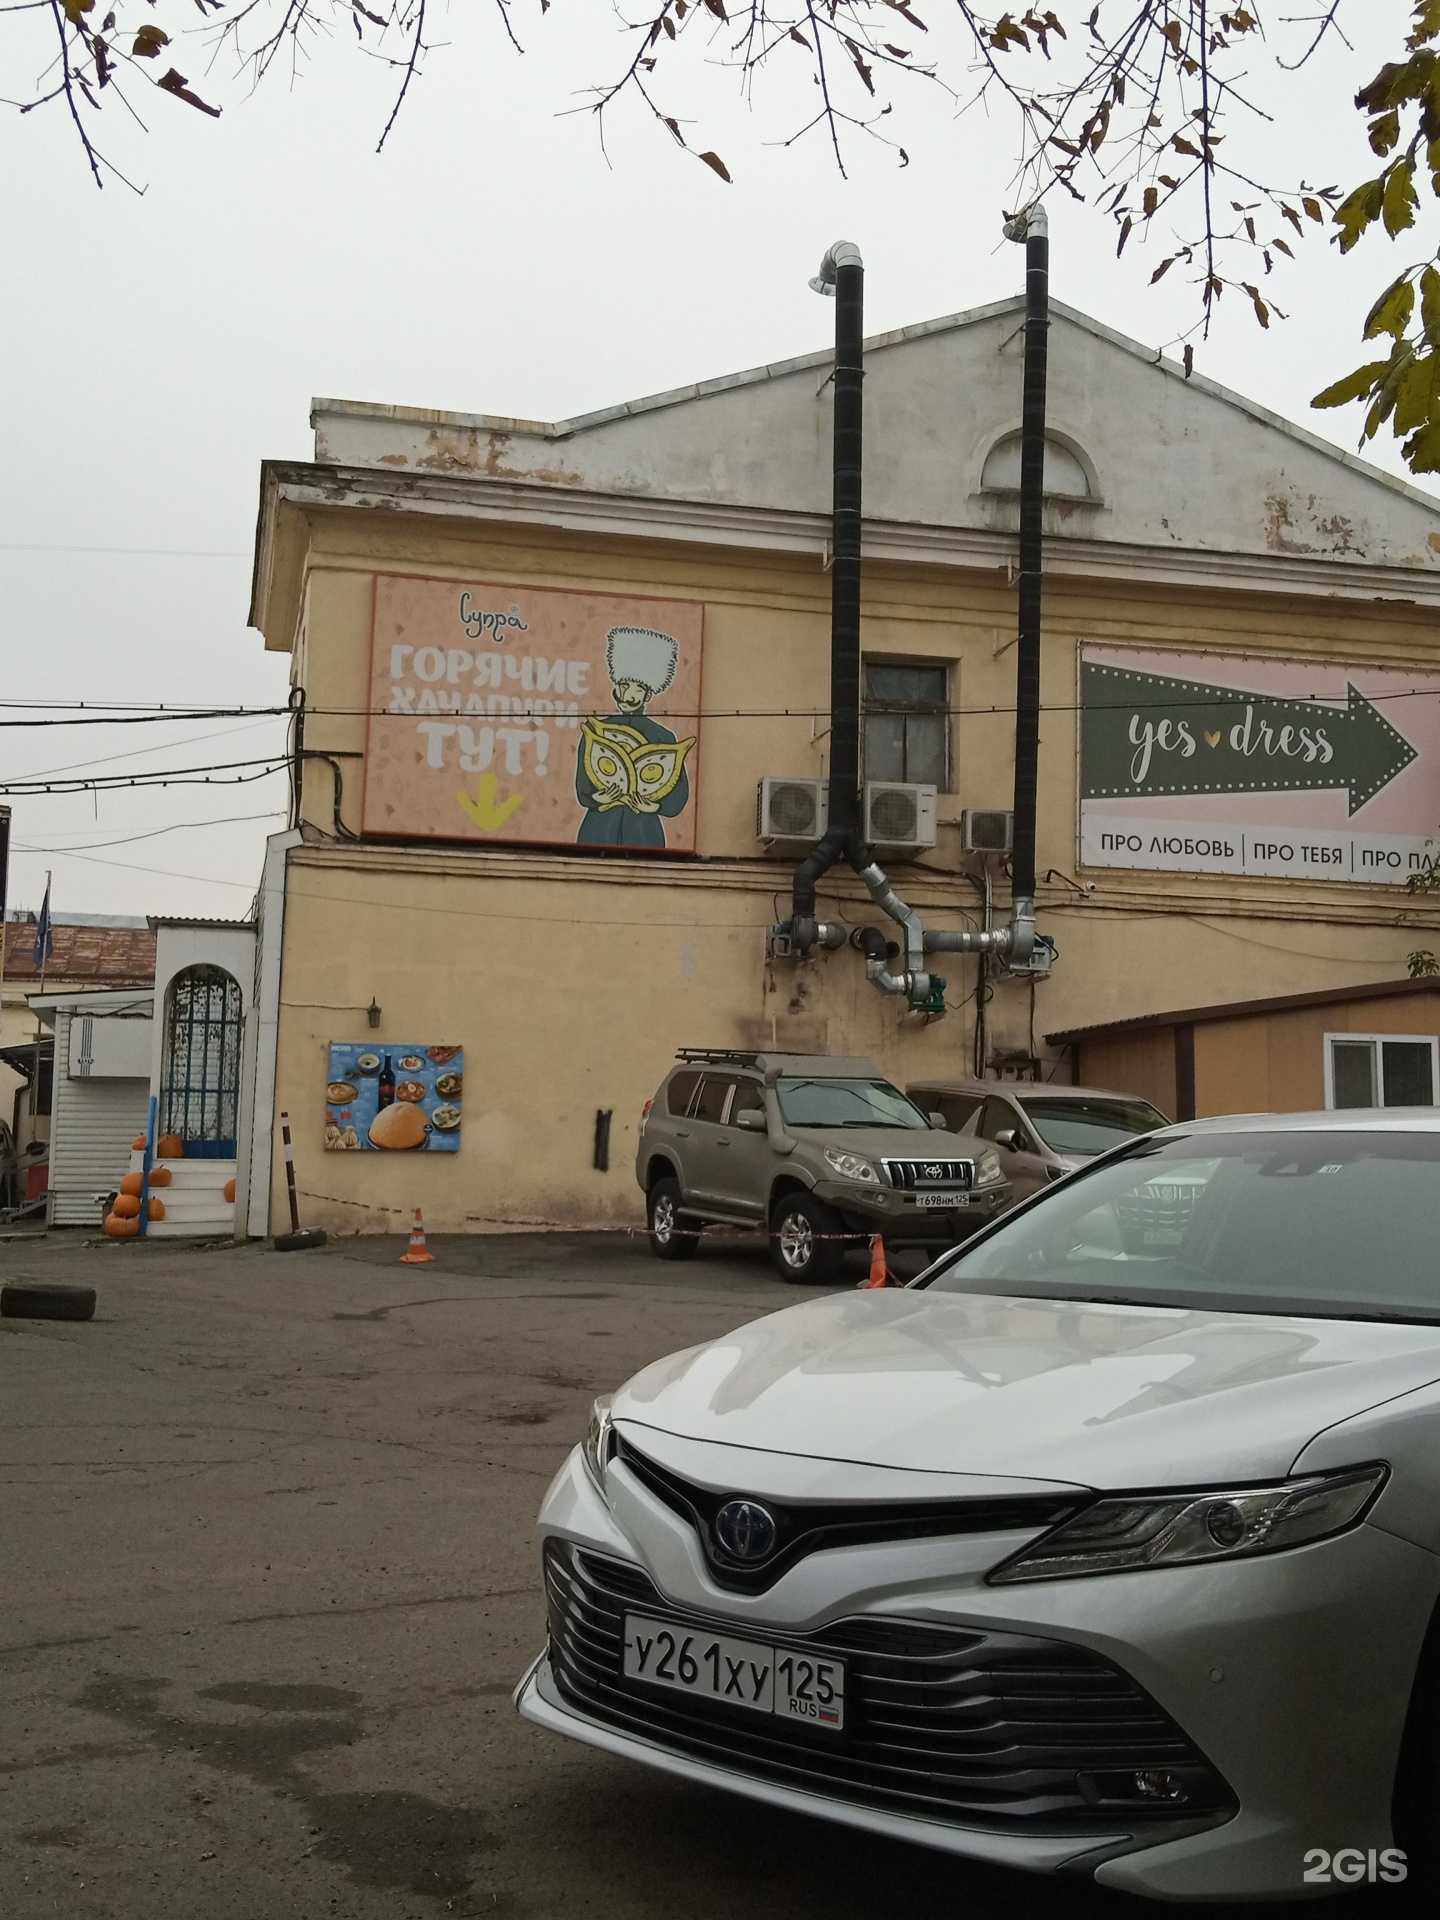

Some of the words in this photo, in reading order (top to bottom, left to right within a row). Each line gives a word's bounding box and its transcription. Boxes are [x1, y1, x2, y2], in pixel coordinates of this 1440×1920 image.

[460, 592, 528, 642] Супра
[390, 644, 592, 695] ГОРЯЧИЕ
[388, 686, 578, 728] ХАЧАПУРИ
[416, 721, 550, 776] ТУТ!
[1128, 713, 1197, 784] yes
[1229, 704, 1334, 764] dress
[1101, 833, 1142, 853] ПРО
[1150, 836, 1234, 858] ЛЮБОВЬ
[1254, 843, 1294, 862] ПРО
[1301, 846, 1343, 866] ТЕБЯ
[1362, 850, 1401, 868] ПРО
[778, 1656, 834, 1704] 125
[789, 1699, 818, 1717] RUS
